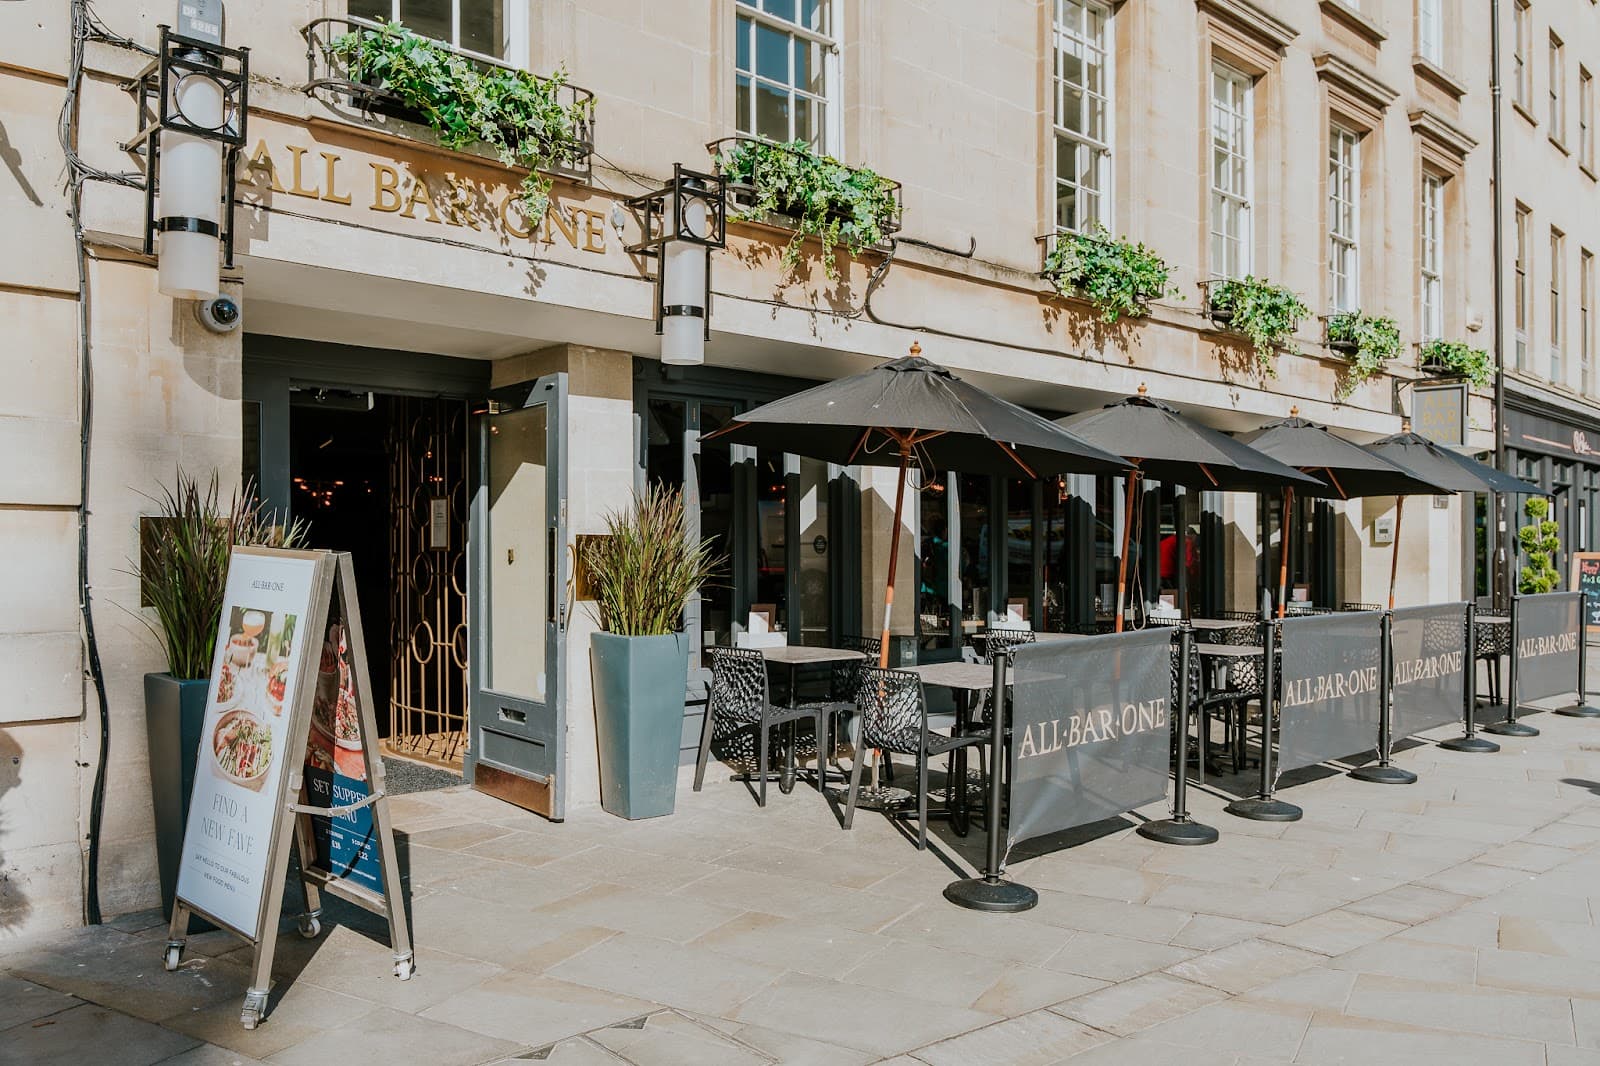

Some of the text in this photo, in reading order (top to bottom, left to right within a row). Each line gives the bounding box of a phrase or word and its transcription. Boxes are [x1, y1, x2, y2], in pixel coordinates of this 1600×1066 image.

[238, 138, 606, 255] ALL BAR ONE
[212, 793, 249, 824] FIND A
[313, 778, 370, 809] SET SUPPER
[201, 816, 254, 855] NEW FAVE
